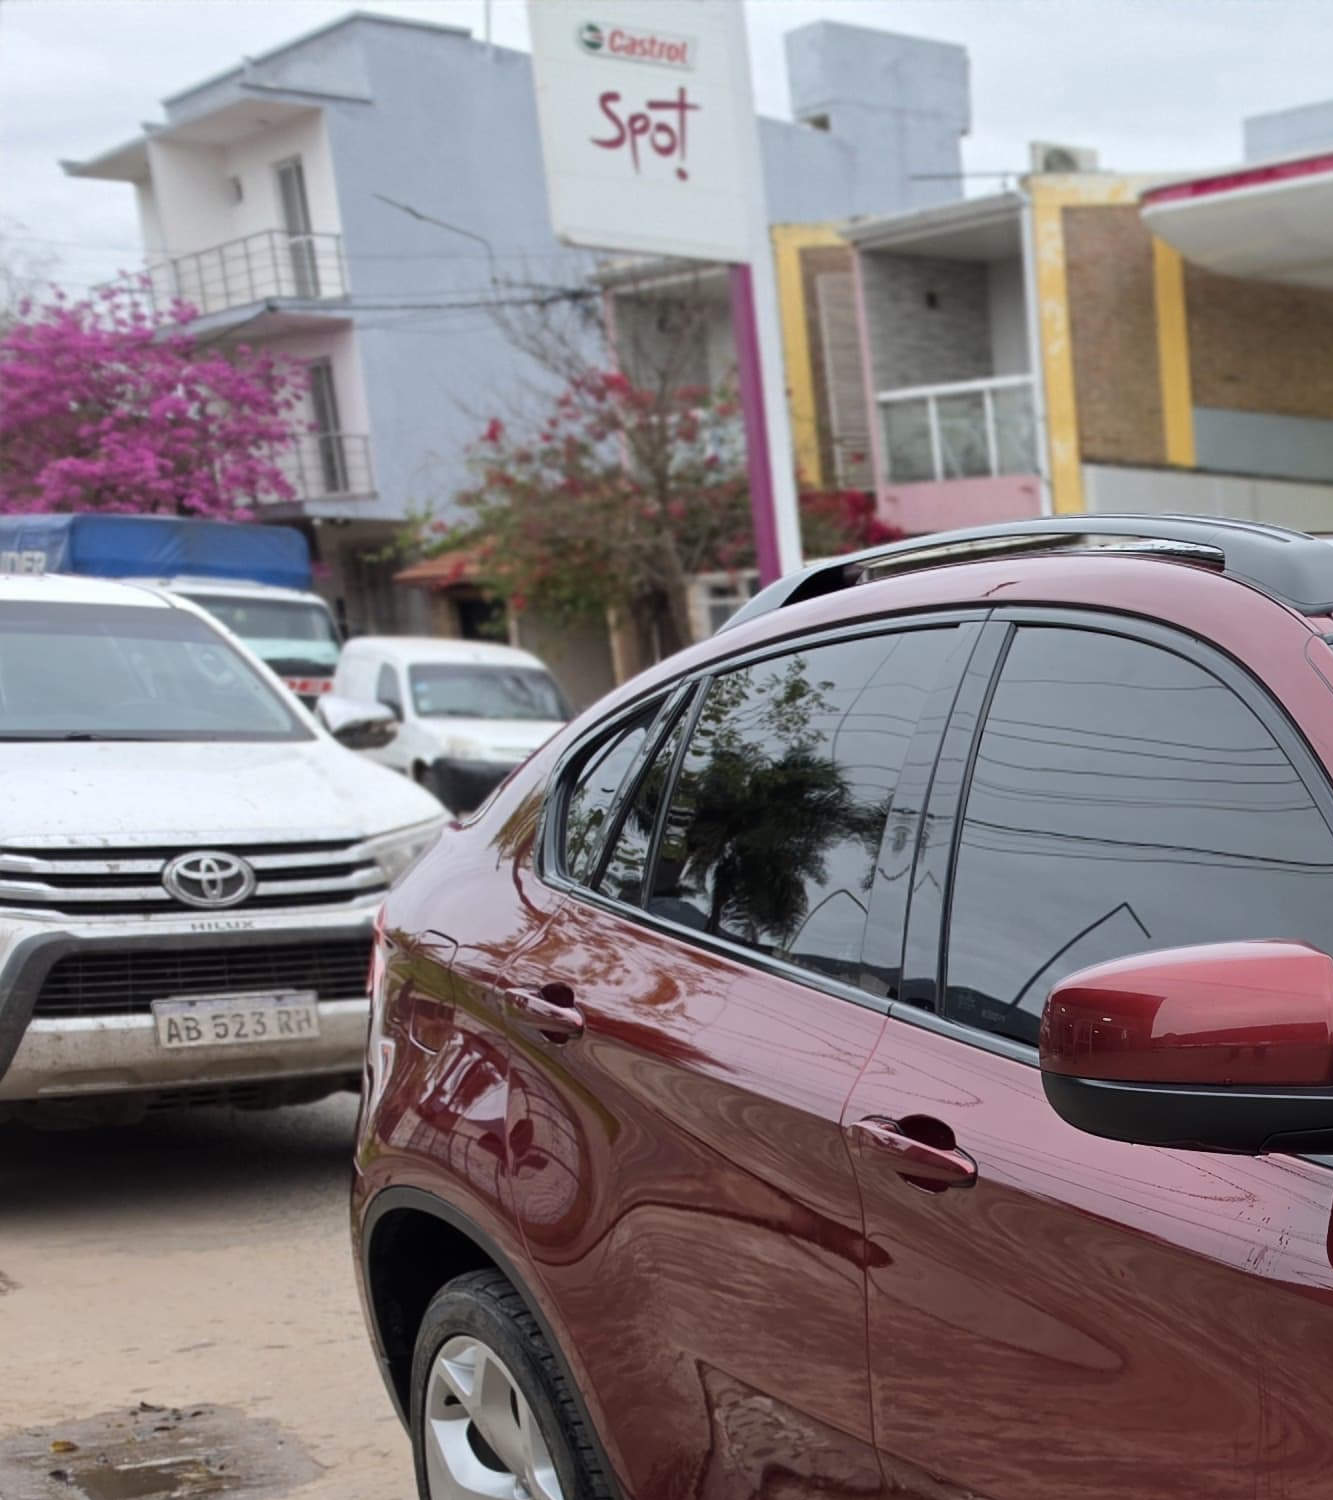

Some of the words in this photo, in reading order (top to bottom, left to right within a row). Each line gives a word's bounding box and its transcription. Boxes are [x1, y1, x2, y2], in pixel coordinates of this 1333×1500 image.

[608, 29, 688, 63] Castrol
[191, 920, 255, 931] HILUX
[167, 1017, 202, 1043] AB
[211, 1012, 267, 1039] 523
[277, 1008, 312, 1034] RH
